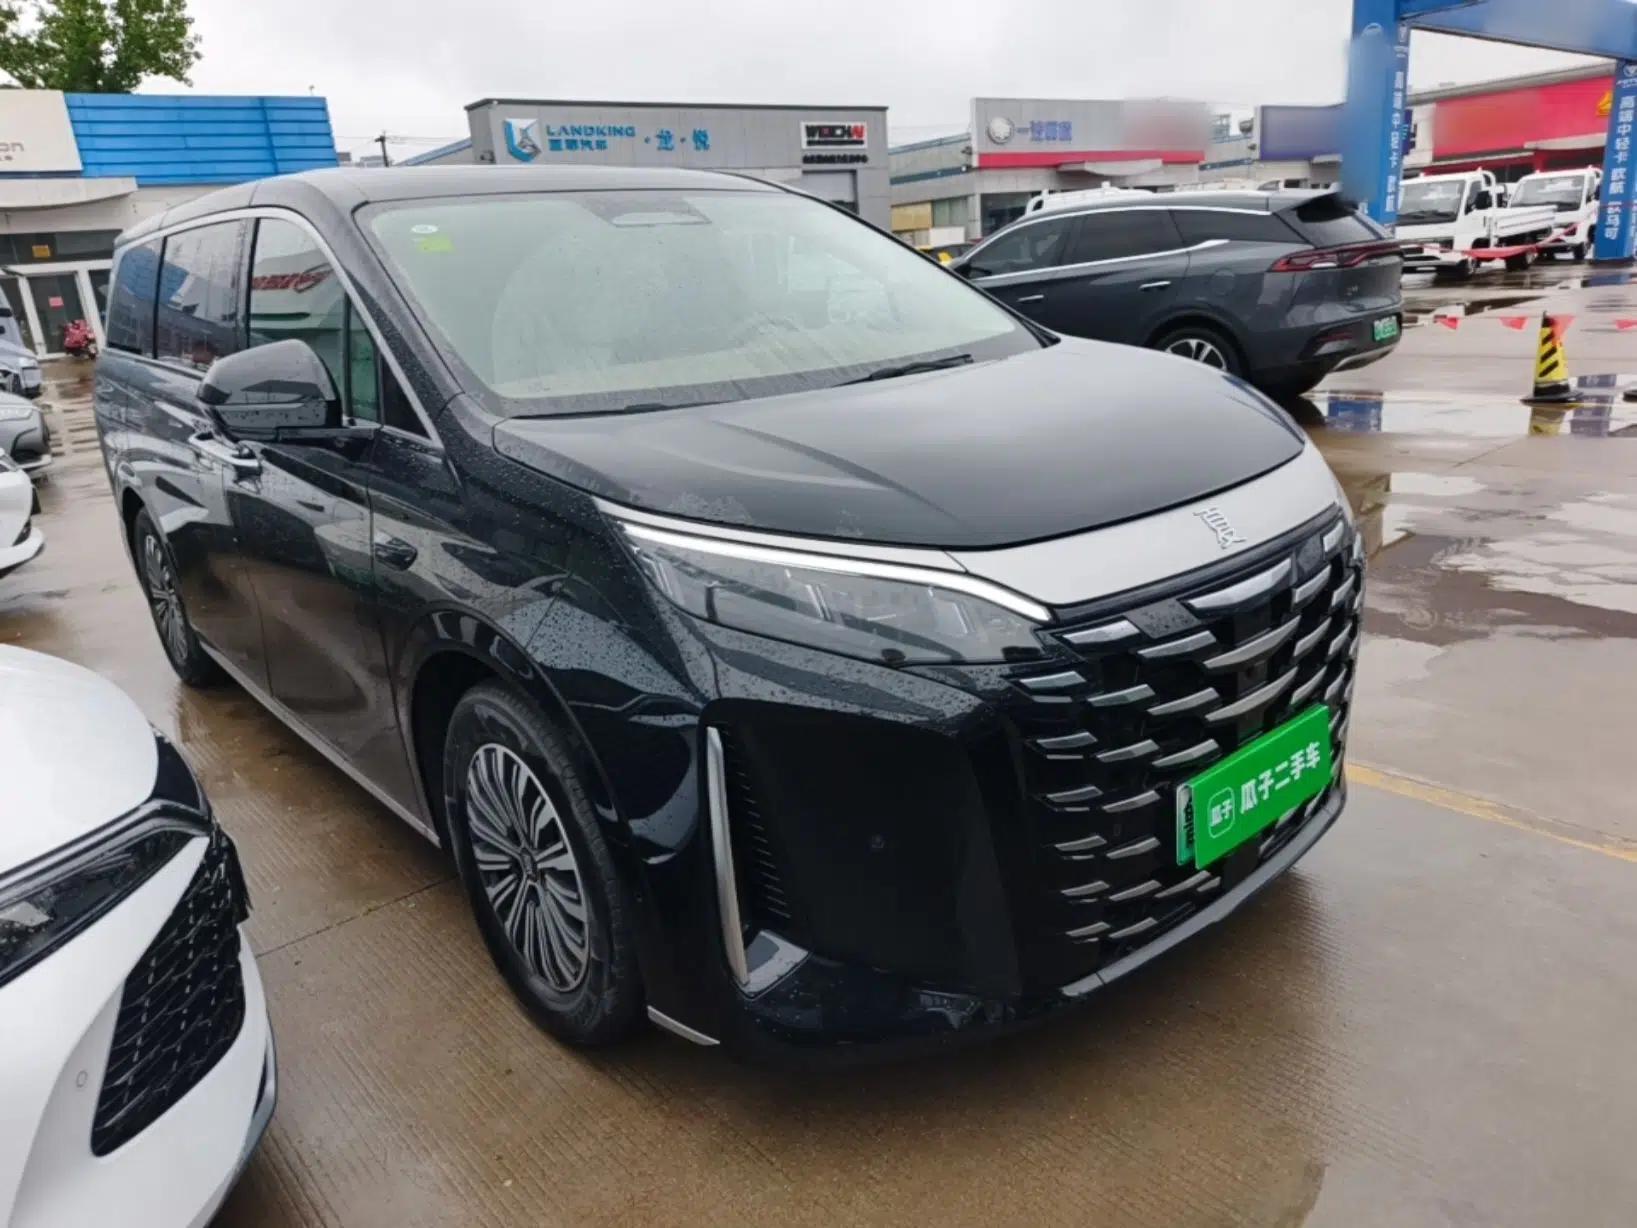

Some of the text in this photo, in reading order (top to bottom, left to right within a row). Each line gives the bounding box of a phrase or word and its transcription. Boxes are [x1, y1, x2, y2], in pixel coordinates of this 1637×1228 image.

[546, 125, 636, 137] LANDKING
[1240, 741, 1321, 815] 瓜子二手车
[1210, 799, 1233, 827] 瓜子
